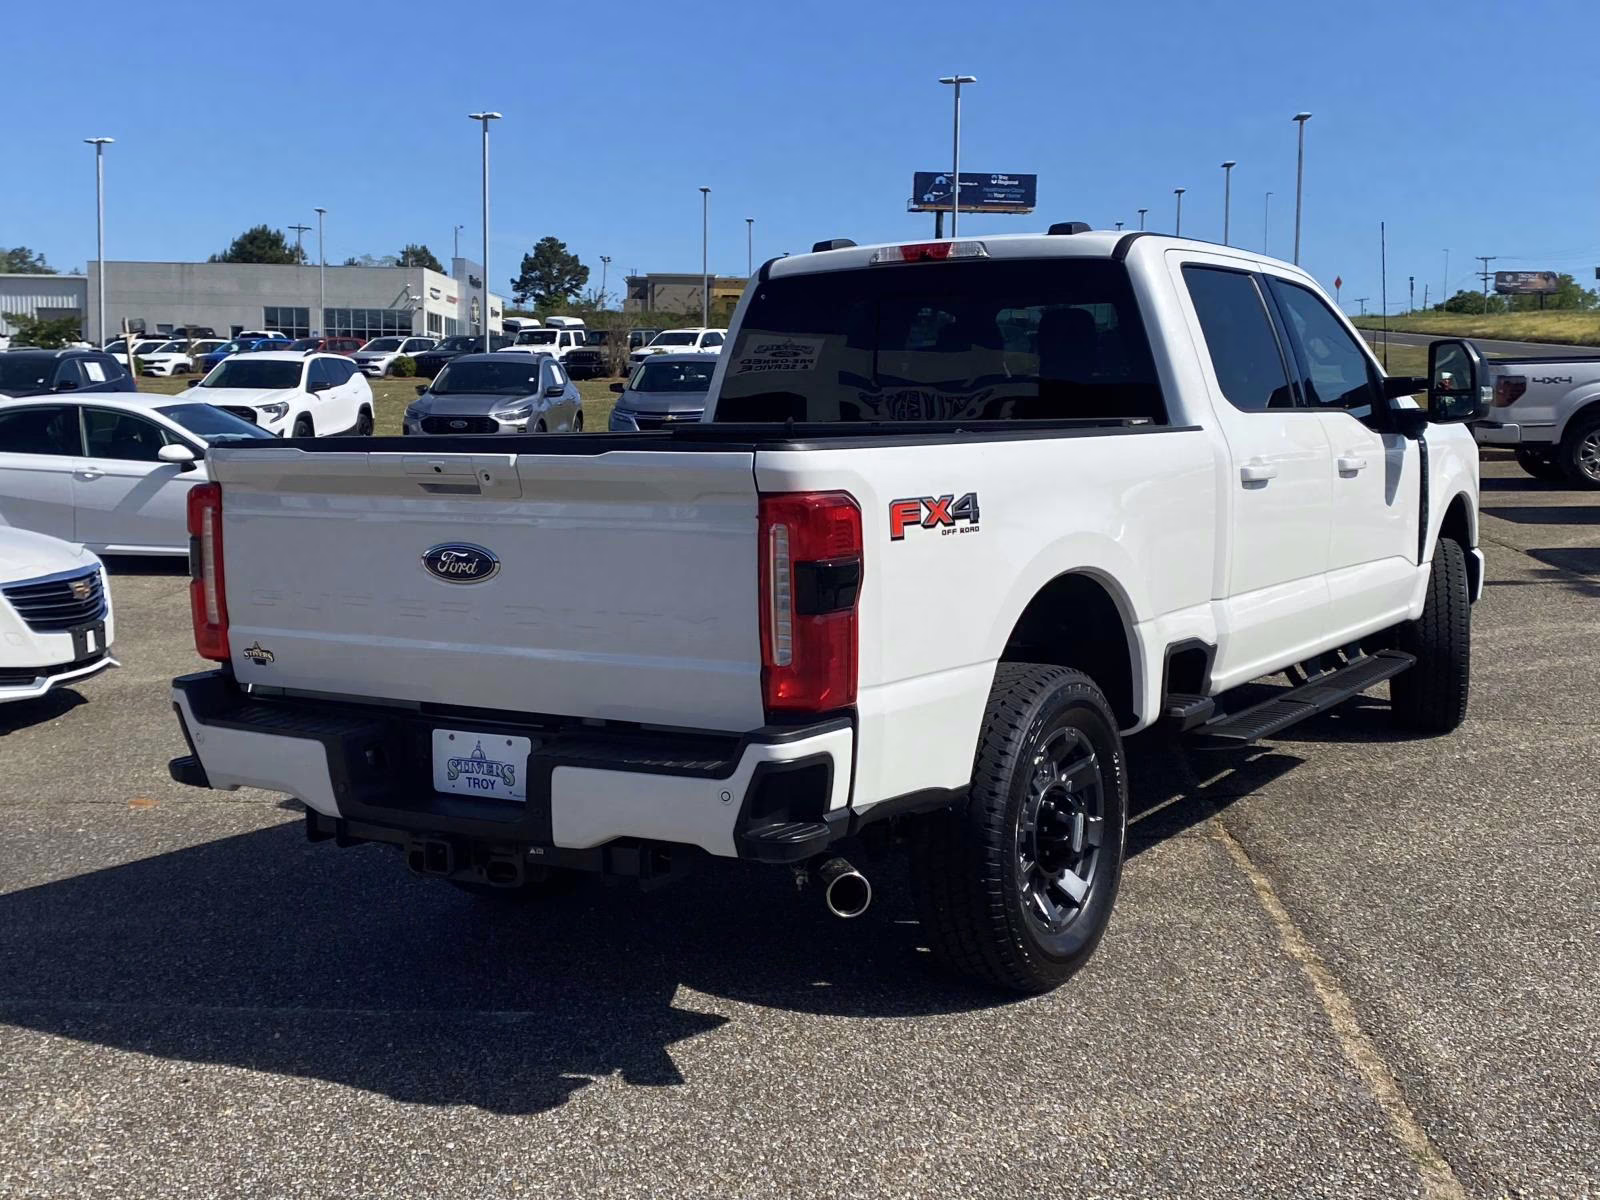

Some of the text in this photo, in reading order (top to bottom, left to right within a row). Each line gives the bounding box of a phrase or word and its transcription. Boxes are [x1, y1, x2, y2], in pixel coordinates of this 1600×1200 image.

[888, 492, 980, 541] FX4
[959, 526, 980, 534] ROAD
[437, 550, 480, 575] Ford
[243, 647, 275, 664] STIVERS
[447, 758, 516, 787] STIVERS
[466, 776, 496, 791] TROY
